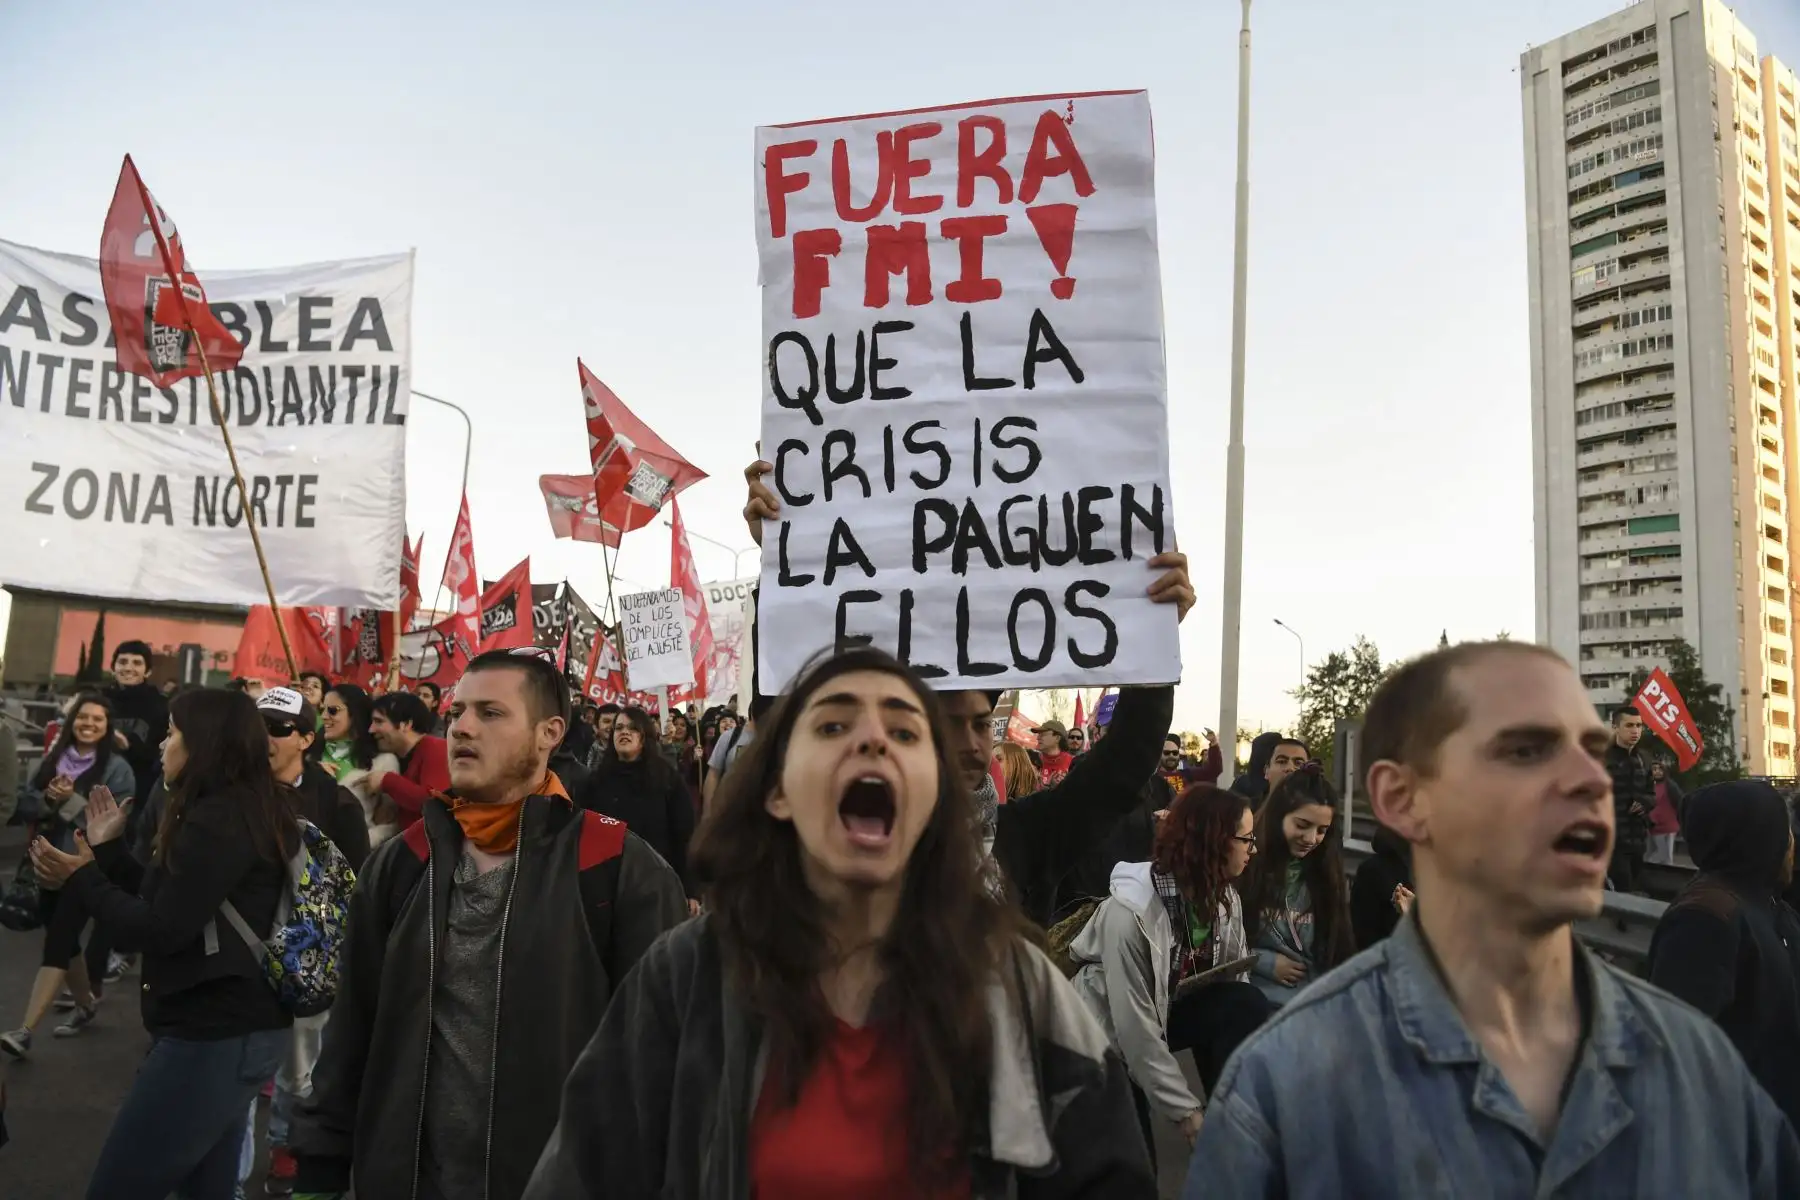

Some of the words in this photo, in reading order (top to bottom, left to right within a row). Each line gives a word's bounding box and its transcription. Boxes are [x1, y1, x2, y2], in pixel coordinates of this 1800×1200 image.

[765, 109, 1097, 238] FUERA
[793, 203, 1078, 318] FMI!
[0, 284, 393, 352] ASBLEA
[769, 320, 914, 425] QUE
[960, 308, 1084, 391] LA
[24, 461, 174, 526] ZONA
[193, 475, 318, 528] NORTE
[775, 416, 1042, 506] CRISIS
[778, 516, 876, 586] LA
[913, 483, 1164, 575] PAGUEN
[625, 622, 683, 643] COMPLICES
[628, 648, 644, 661] DEL
[647, 636, 683, 656] AJUSTE
[629, 611, 641, 624] DE
[651, 606, 673, 621] LOS
[1643, 679, 1680, 723] PTS
